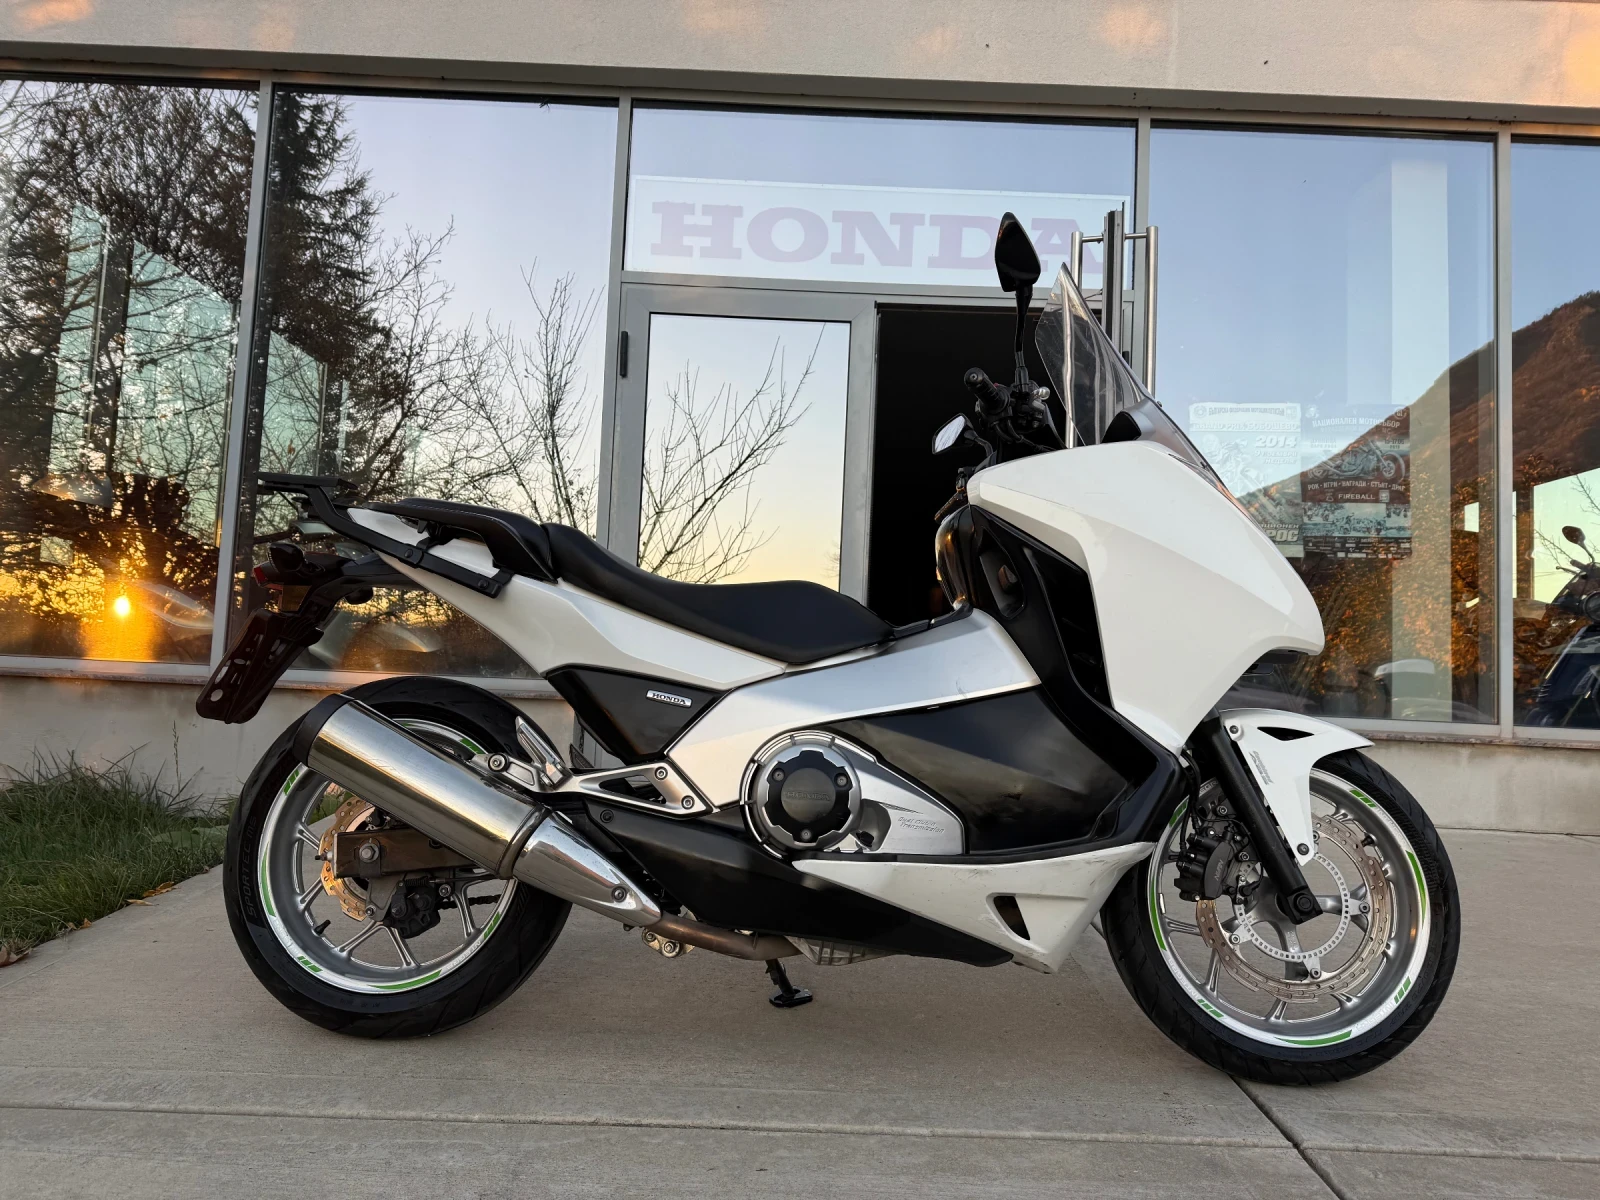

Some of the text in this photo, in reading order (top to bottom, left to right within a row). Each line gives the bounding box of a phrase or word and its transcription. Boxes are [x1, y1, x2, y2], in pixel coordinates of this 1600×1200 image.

[650, 201, 1101, 274] HONDA
[1312, 417, 1357, 428] НАЦИОНАЛЕН
[1255, 435, 1298, 449] 2014
[1323, 481, 1338, 489] ИГРИ
[652, 692, 686, 705] HONDA
[784, 791, 831, 802] HONDA
[240, 841, 258, 919] SPORTEC
